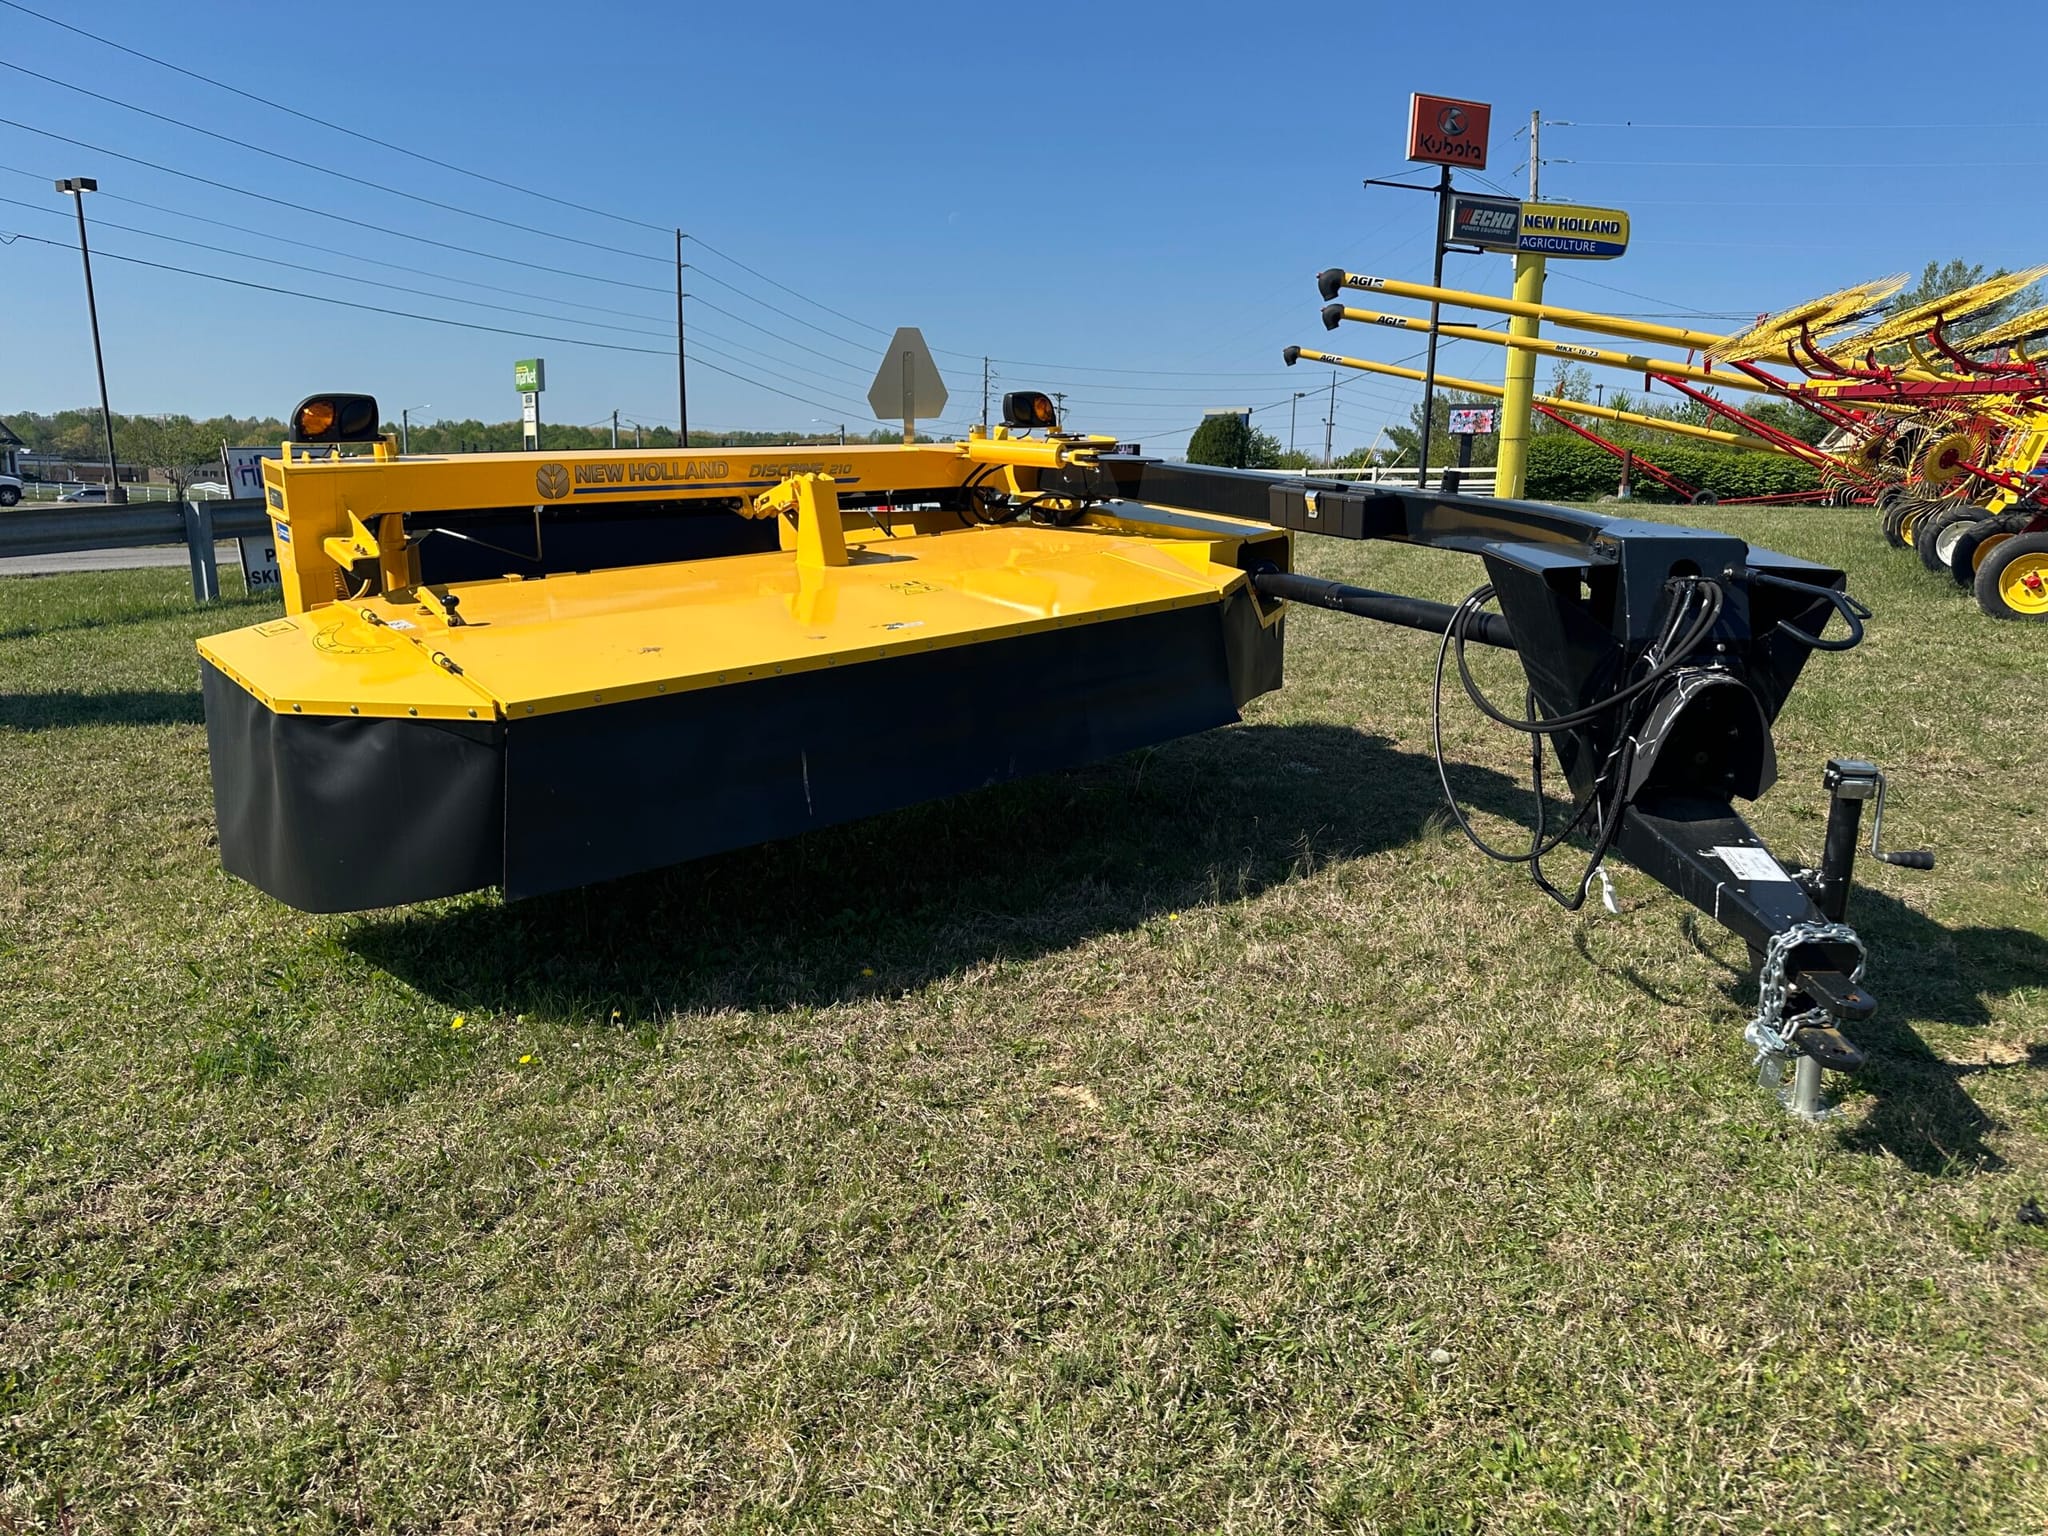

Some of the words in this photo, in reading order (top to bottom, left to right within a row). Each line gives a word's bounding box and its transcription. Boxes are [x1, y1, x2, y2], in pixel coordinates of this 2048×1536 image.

[1420, 133, 1481, 159] Kubota
[1469, 209, 1516, 230] ECHO
[1523, 214, 1555, 229] NEW
[1558, 216, 1621, 234] HOLLAND
[1461, 224, 1480, 232] POWER
[1480, 226, 1511, 235] EQUIPMENT
[1520, 236, 1596, 252] AGRICULTURE
[1348, 275, 1374, 287] AGI
[1376, 315, 1397, 326] AGI
[574, 464, 625, 484] NEW
[628, 460, 729, 482] HOLLAND
[828, 464, 853, 474] 210
